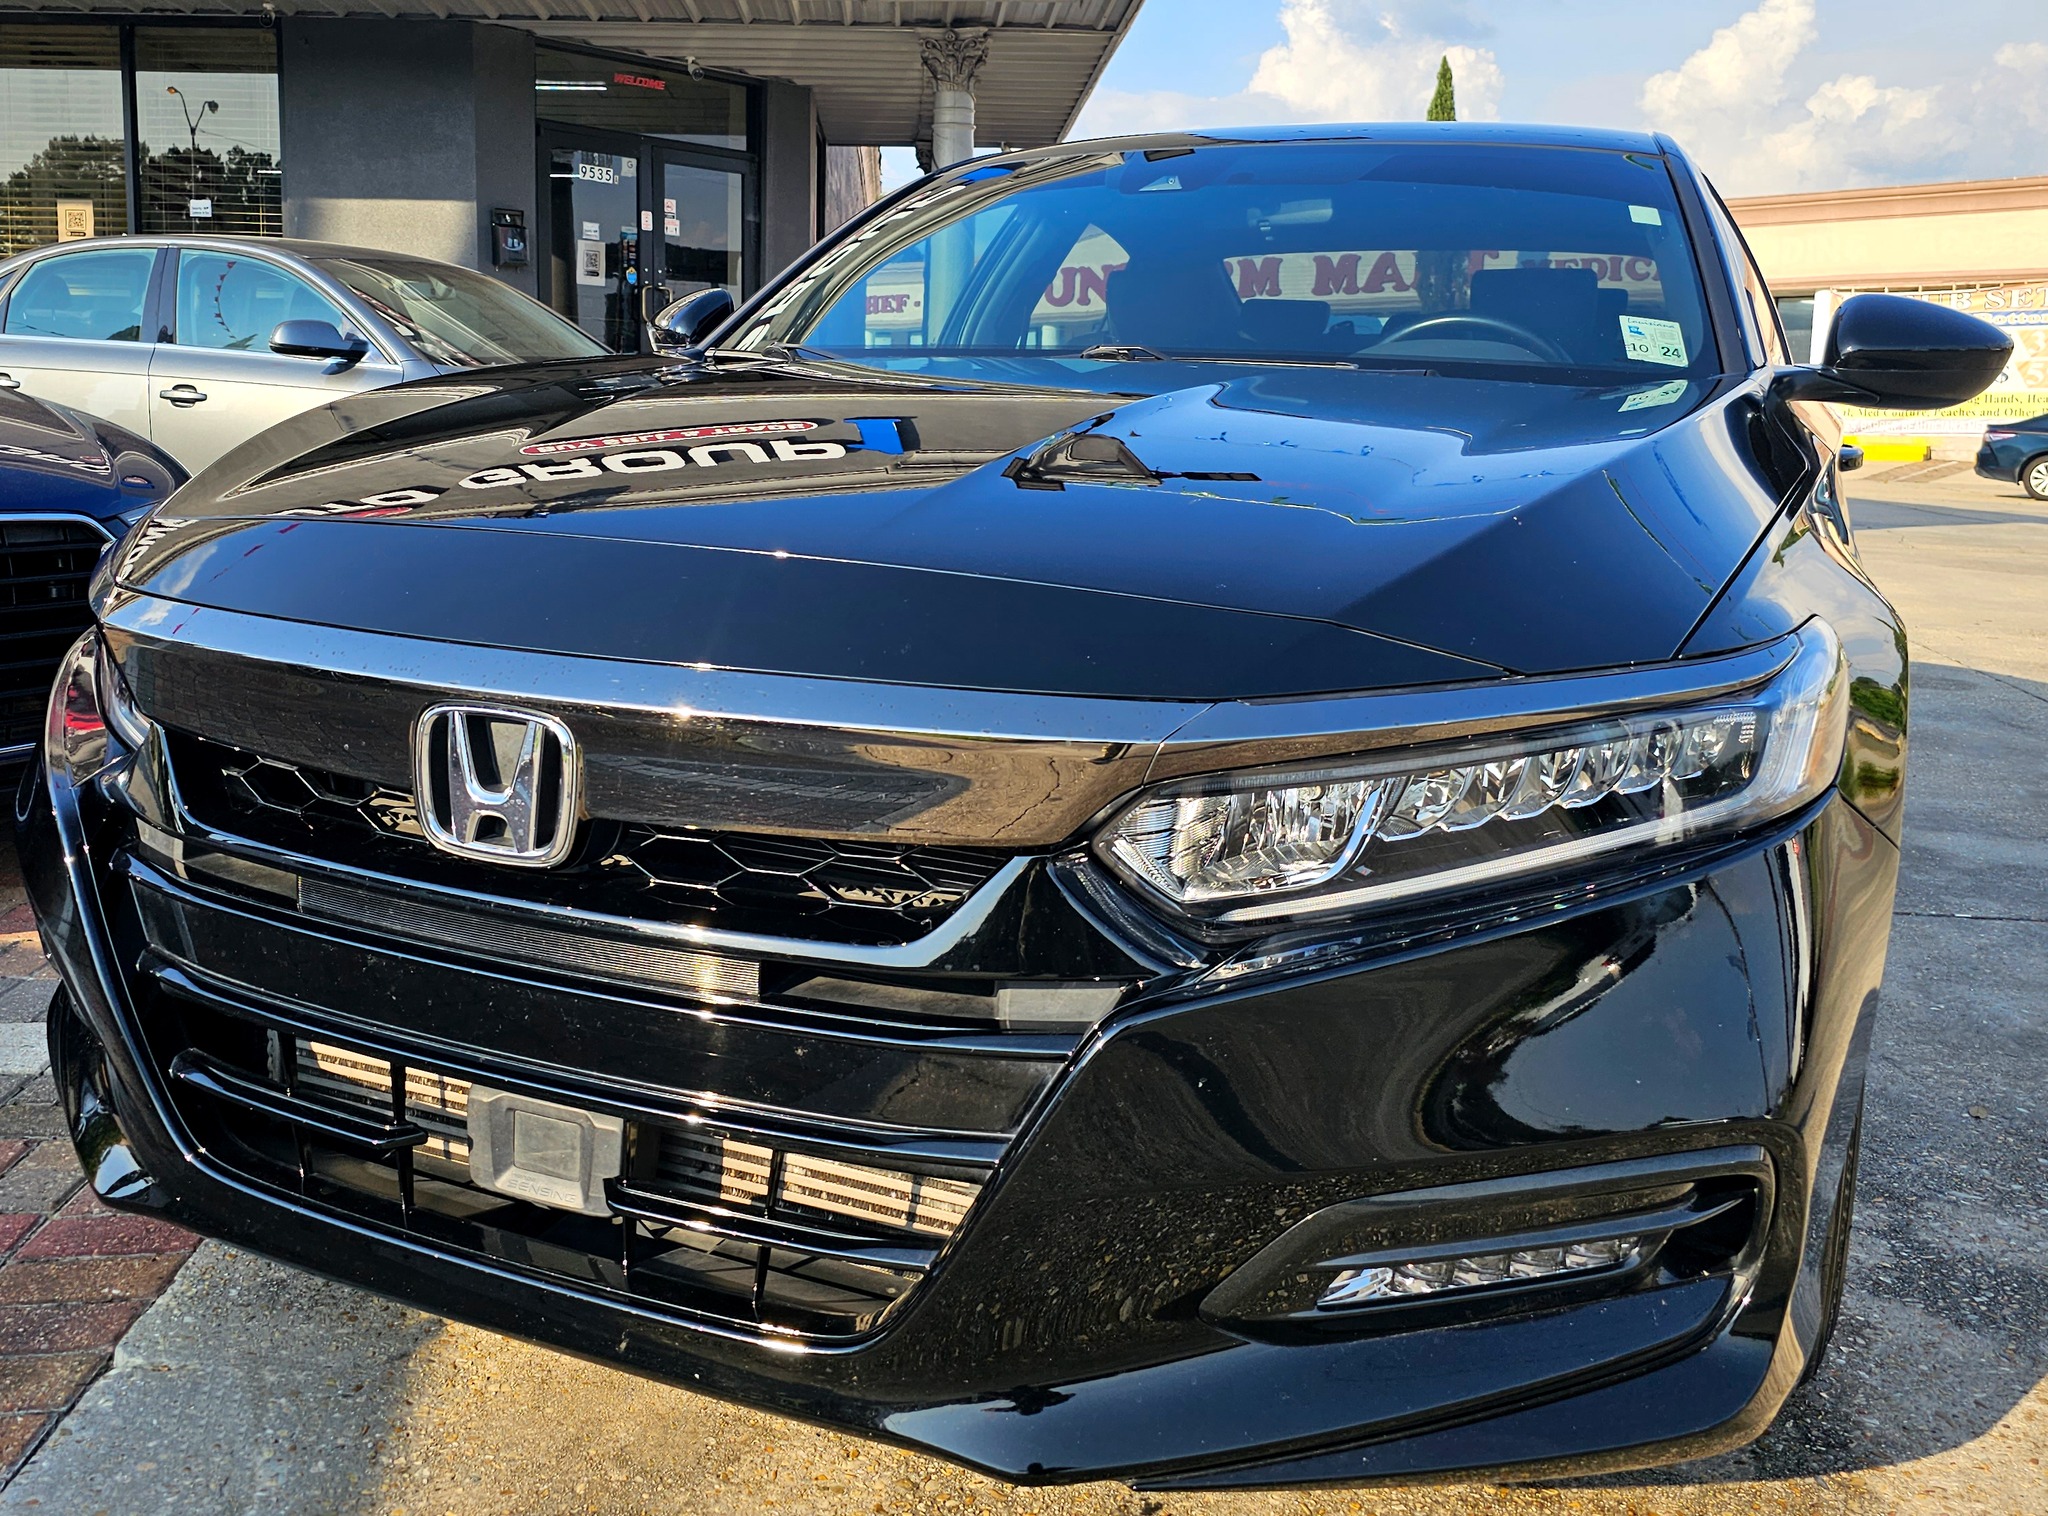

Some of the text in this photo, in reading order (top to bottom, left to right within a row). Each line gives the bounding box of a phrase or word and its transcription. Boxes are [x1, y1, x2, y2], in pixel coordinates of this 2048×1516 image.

[613, 73, 666, 91] WELCOME
[580, 165, 612, 183] 9535
[866, 294, 910, 316] HEF
[1630, 342, 1649, 353] 10
[1661, 345, 1681, 359] 24
[1934, 406, 1977, 417] Peaches
[1980, 407, 2000, 417] and
[2005, 405, 2036, 418] Other
[506, 1178, 577, 1204] SENSING
